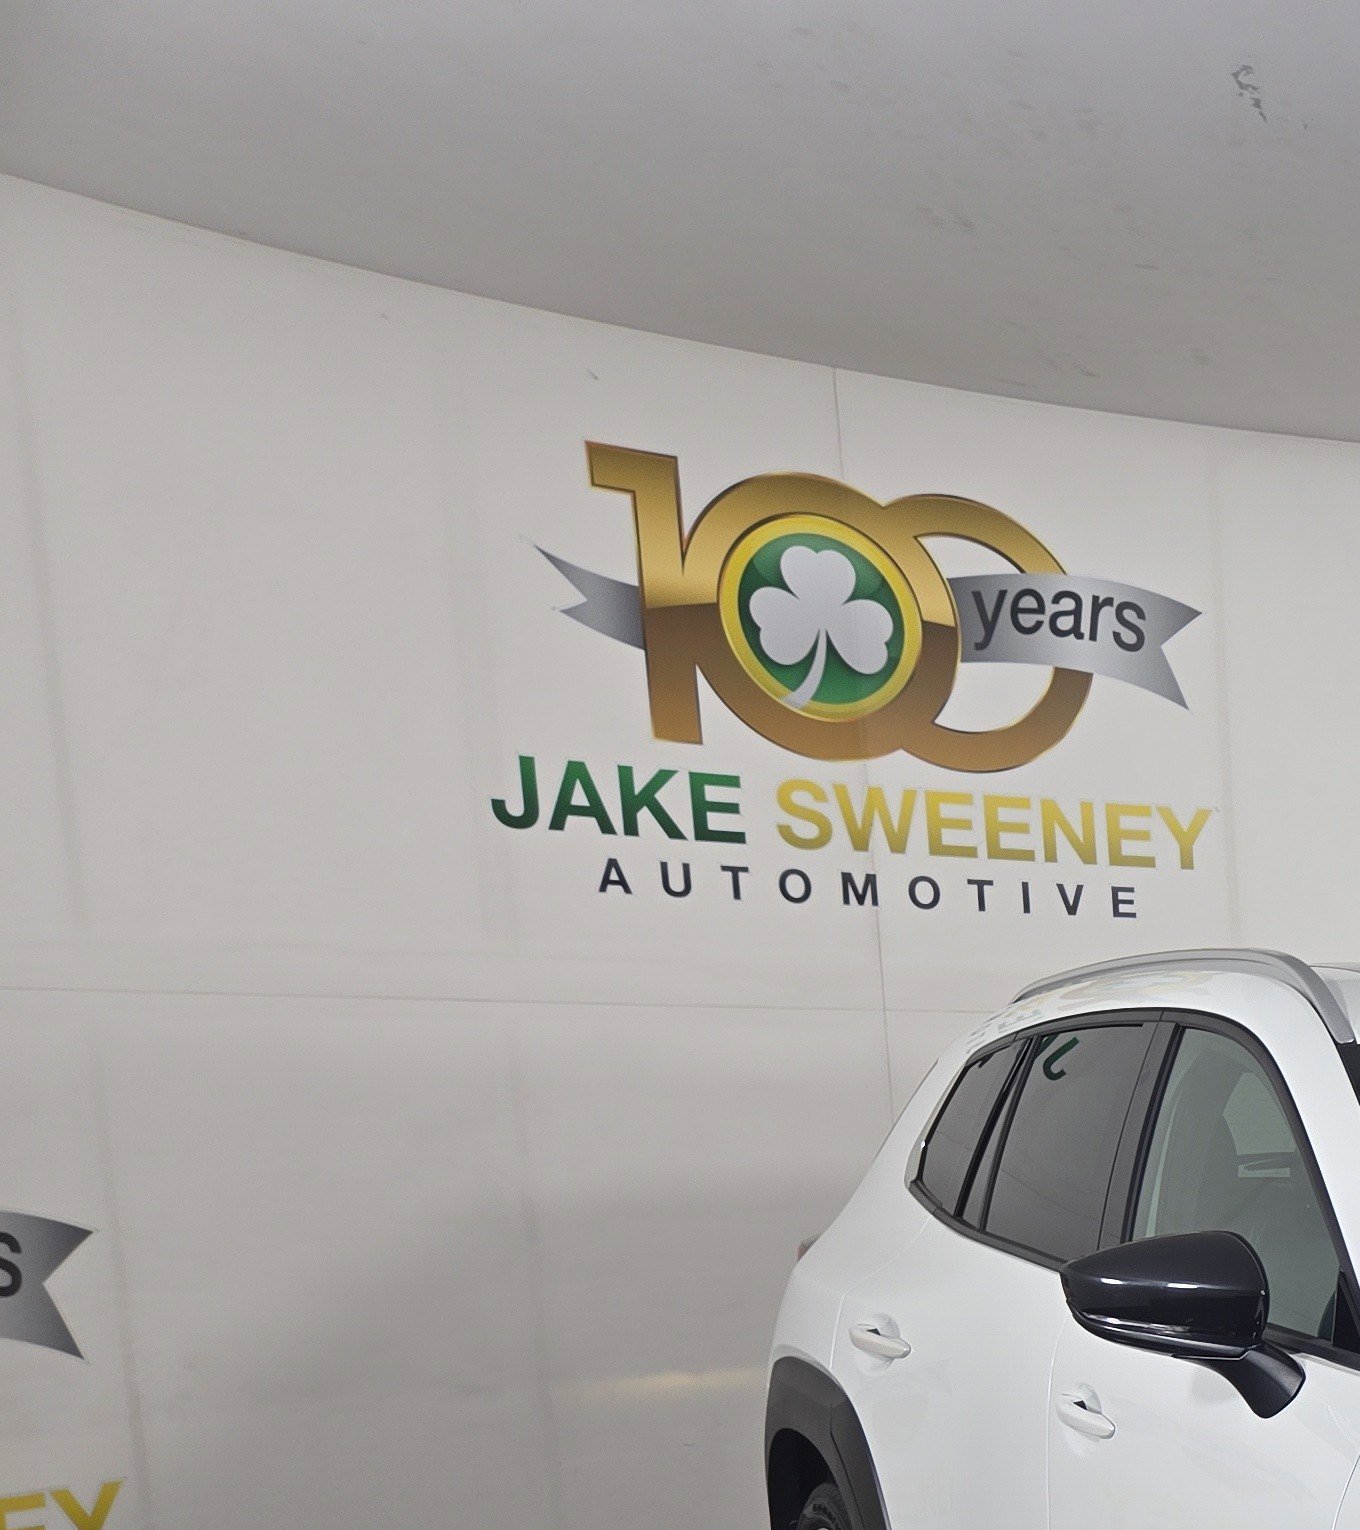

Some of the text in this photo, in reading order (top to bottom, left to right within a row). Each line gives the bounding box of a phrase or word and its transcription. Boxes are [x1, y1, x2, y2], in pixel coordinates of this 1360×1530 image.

[586, 440, 1147, 773] 100 years
[490, 755, 1212, 870] JAKE SWEENEY
[599, 858, 1137, 919] AUTOMOTIVE
